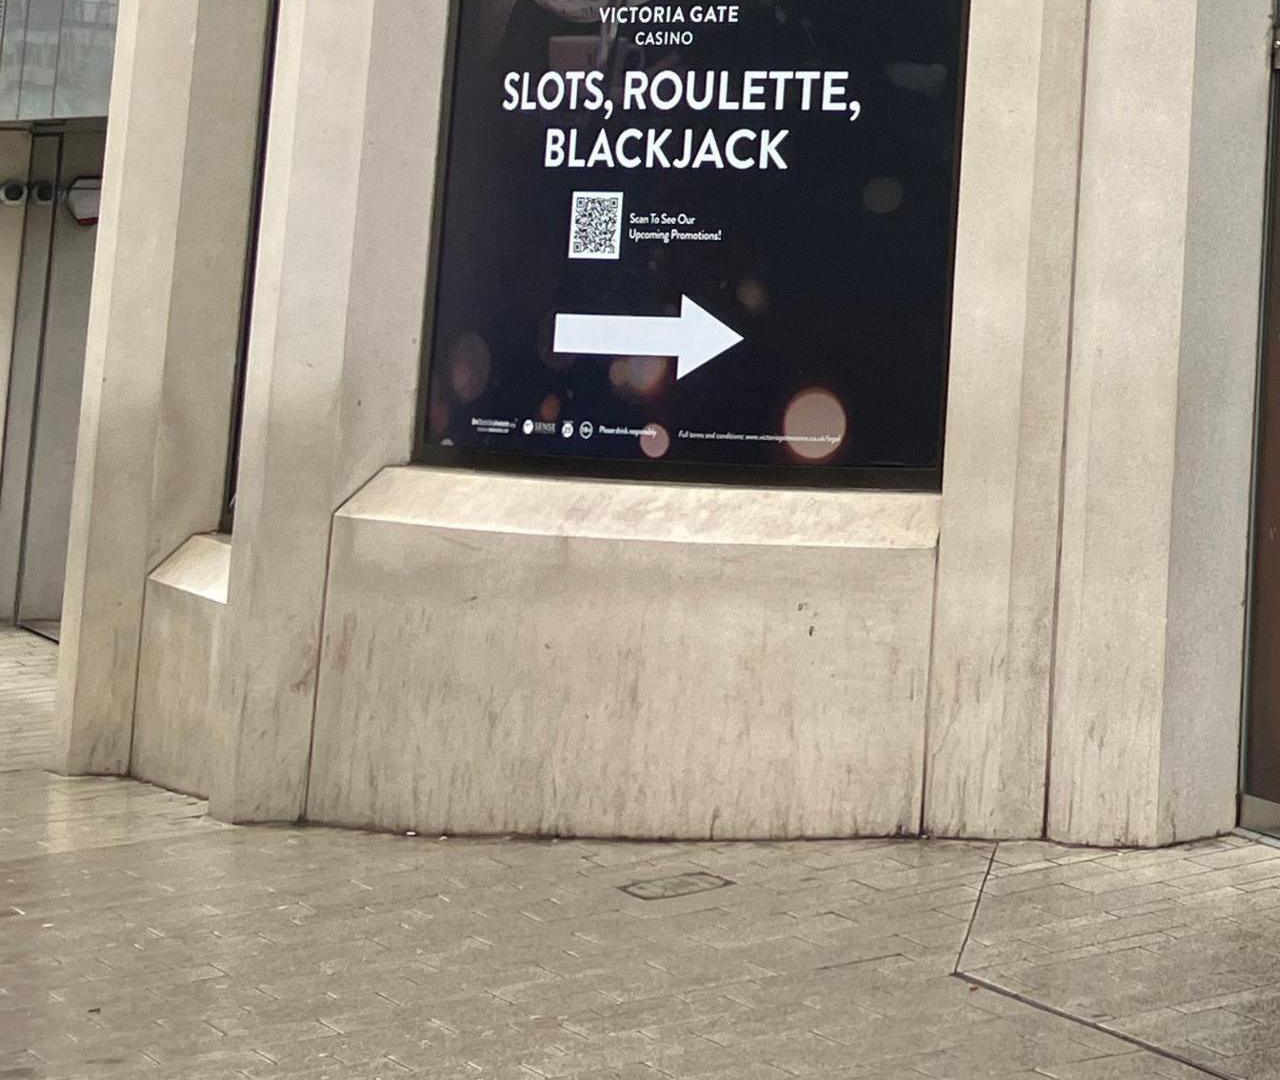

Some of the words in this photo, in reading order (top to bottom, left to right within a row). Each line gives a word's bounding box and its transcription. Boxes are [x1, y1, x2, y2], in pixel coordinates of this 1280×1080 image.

[599, 6, 685, 23] VICTORIA
[690, 6, 740, 22] GATE
[635, 31, 693, 45] CASINO
[502, 71, 614, 120] SLOTS,
[623, 70, 861, 121] ROULETTE,
[544, 128, 789, 170] BLACKJACK
[629, 212, 649, 224] Scan
[650, 213, 660, 224] To
[661, 212, 676, 224] See
[677, 213, 695, 225] Our
[628, 228, 669, 243] Upcoming
[671, 228, 722, 241] Promotions!
